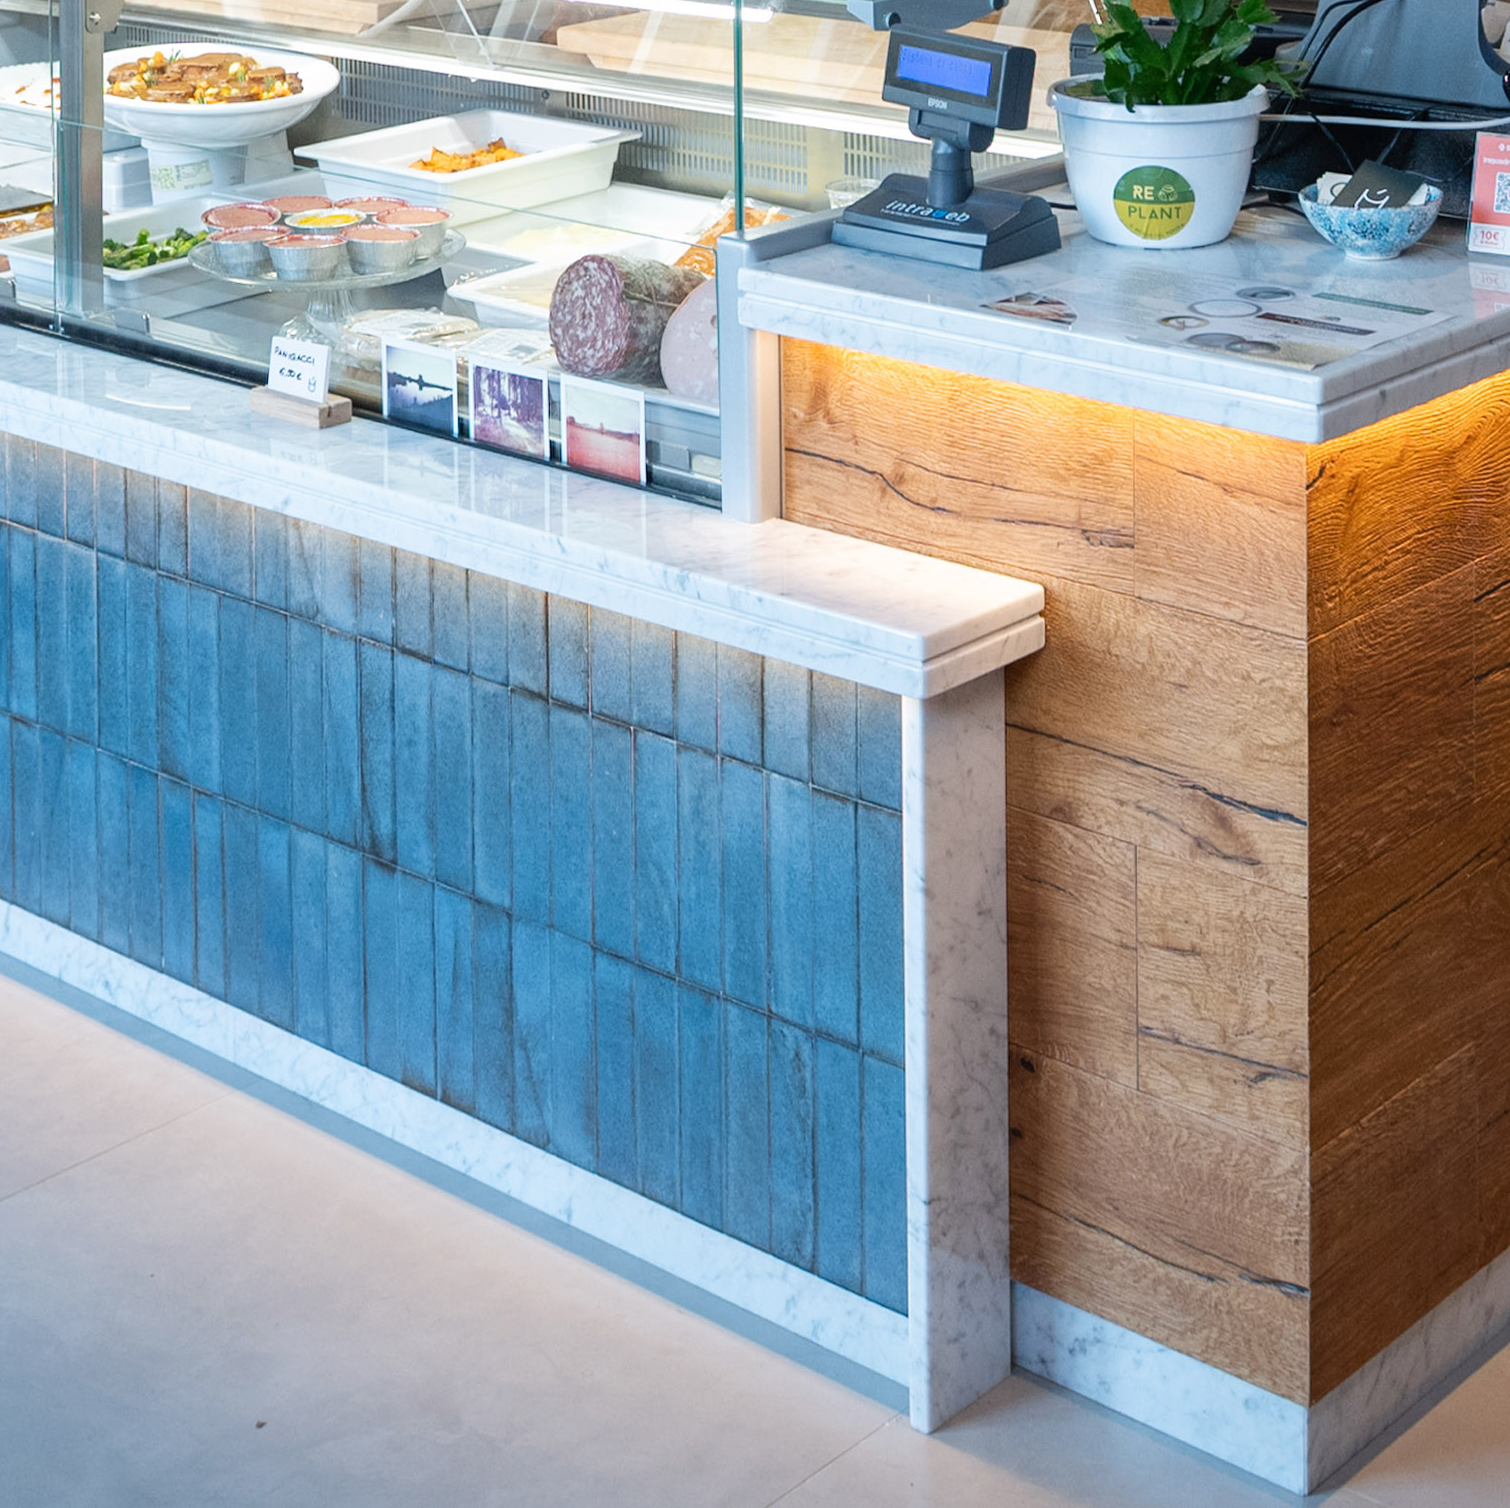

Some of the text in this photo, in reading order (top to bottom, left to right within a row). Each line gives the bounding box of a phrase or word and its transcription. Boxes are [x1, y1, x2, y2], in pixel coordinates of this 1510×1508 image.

[927, 97, 948, 110] EPSON
[1132, 184, 1155, 201] RE
[885, 200, 971, 223] intraweb
[1127, 205, 1182, 220] PLANT
[1481, 230, 1499, 241] 10€
[274, 345, 316, 366] PANIGACCI
